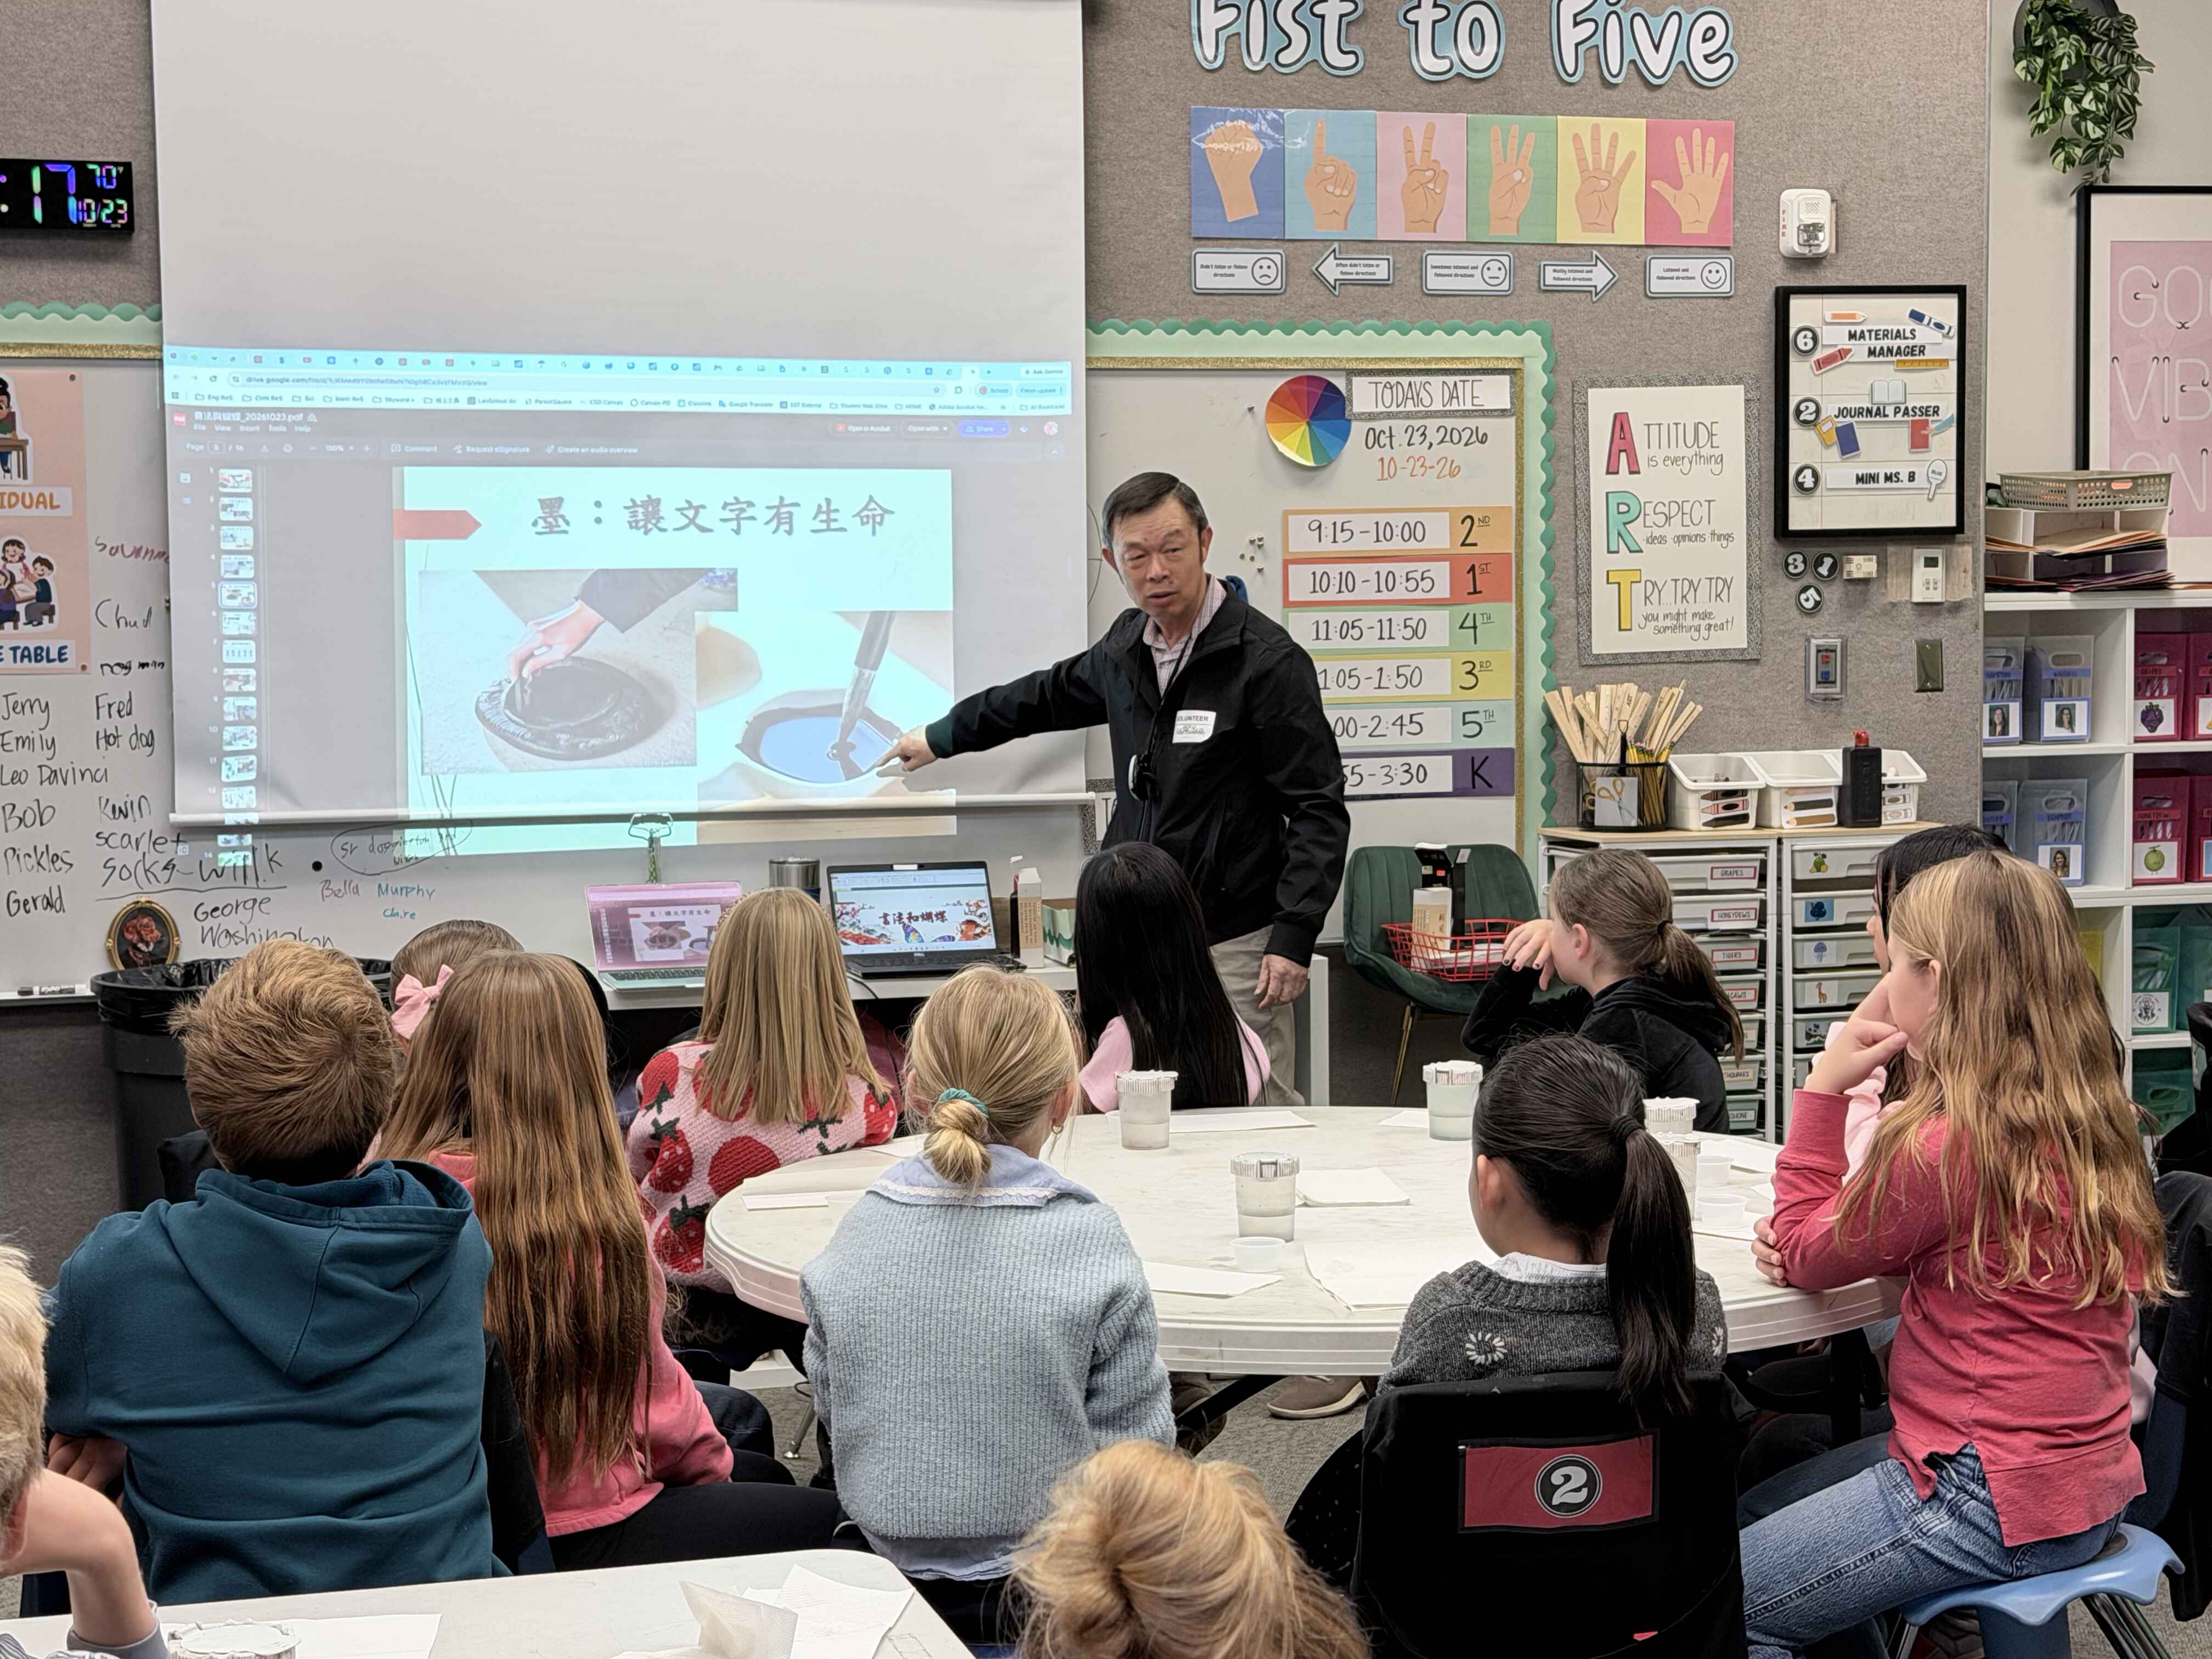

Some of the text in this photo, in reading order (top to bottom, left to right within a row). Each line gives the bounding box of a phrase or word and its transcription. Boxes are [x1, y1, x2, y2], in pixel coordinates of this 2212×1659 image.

[1195, 0, 1734, 84] Fist to Five
[78, 199, 127, 223] 10/23
[1796, 330, 1814, 351] 6
[1848, 329, 1916, 342] MATERIALS
[1867, 345, 1926, 358] MANAGER
[1368, 380, 1485, 409] TODAYS DATE
[1799, 402, 1816, 422] 2
[1833, 405, 1940, 419] JOURNAL PASSER
[1377, 455, 1461, 481] 10-23-26
[1647, 450, 1724, 476] is everything
[1798, 468, 1815, 488] 4
[1855, 471, 1916, 484] MINI MS. B
[1788, 554, 1834, 577] 3 1
[1799, 588, 1821, 610] 5
[1638, 608, 1716, 629] you might make
[1653, 616, 1734, 641] something great!
[9, 645, 69, 664] TABLE
[2, 692, 50, 730] Jerry
[95, 691, 133, 720] Fred
[0, 730, 57, 760] Emily
[96, 724, 155, 757] Hot dog
[0, 761, 109, 786] Leo Davinci
[1471, 755, 1493, 789] K
[2, 799, 56, 833] Bob
[99, 794, 151, 822] Kevin
[95, 829, 188, 853] scarlet
[4, 844, 74, 875] Pickles
[7, 885, 65, 917] Gerald
[320, 879, 435, 902] Bella Murphy
[194, 896, 271, 925] George
[383, 907, 416, 919] Claire
[1718, 911, 1751, 919] HONEYDEWS
[1550, 1465, 1588, 1505] 2
